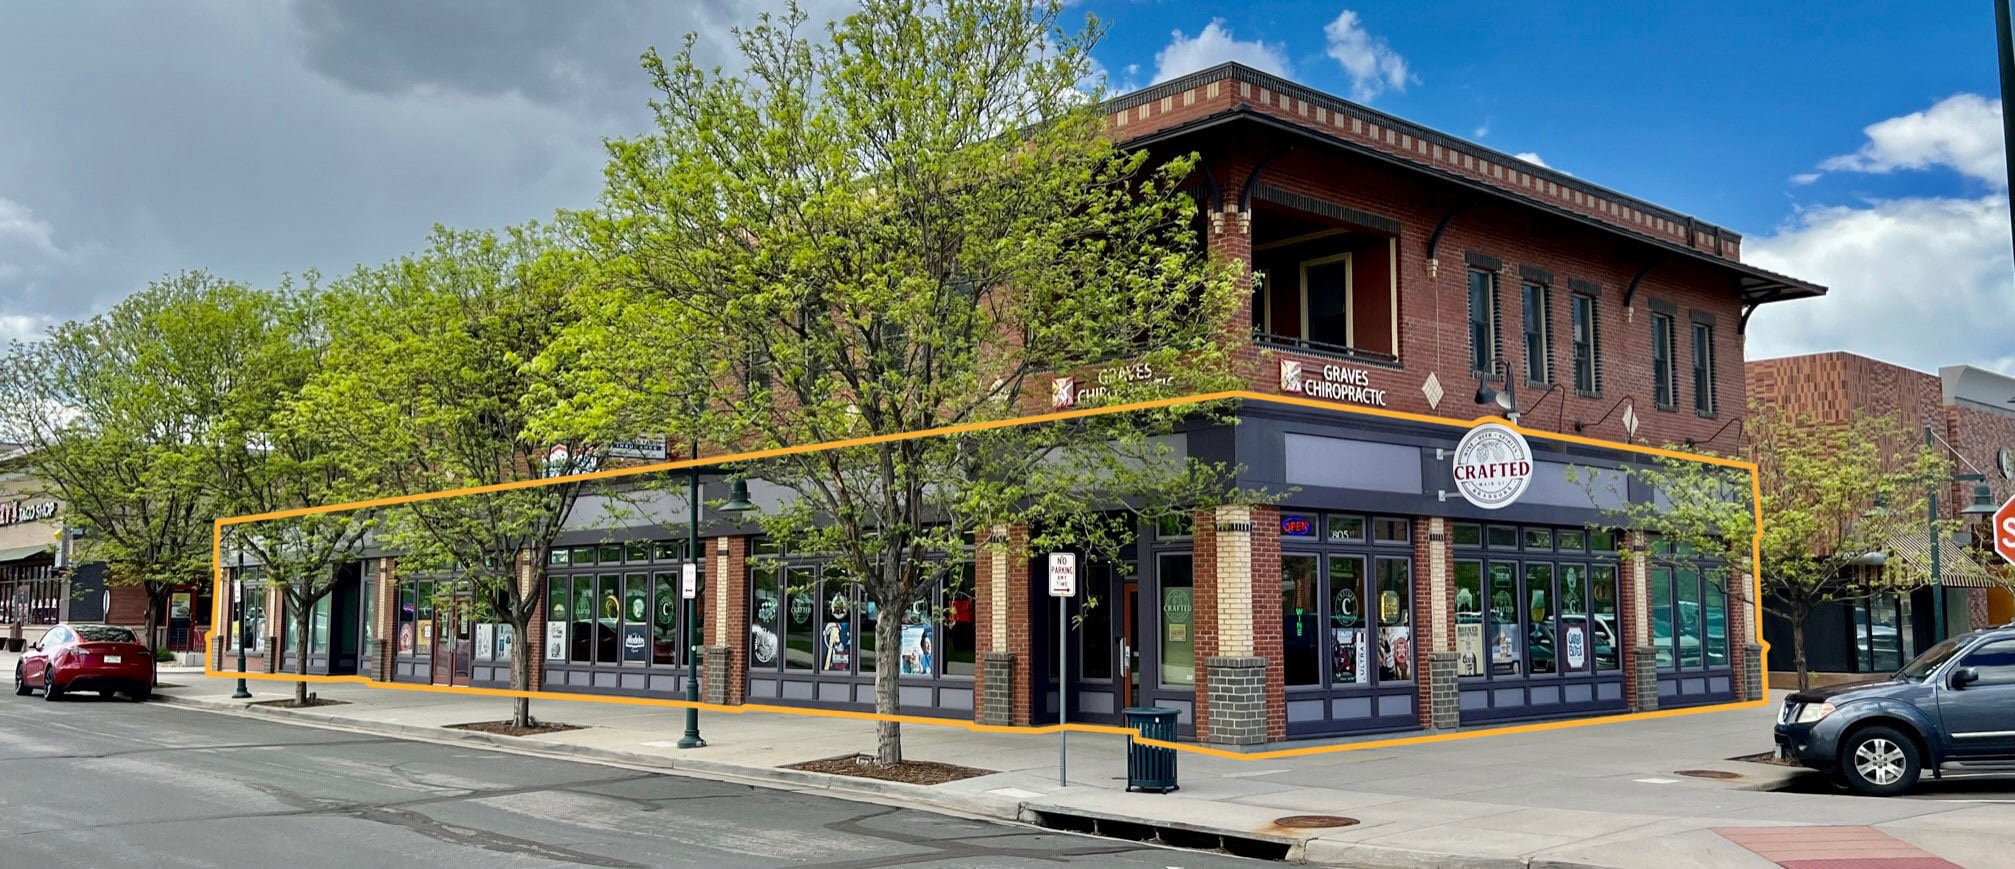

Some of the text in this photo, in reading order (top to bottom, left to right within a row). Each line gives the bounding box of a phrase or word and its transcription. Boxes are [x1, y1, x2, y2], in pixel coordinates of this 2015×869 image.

[1097, 363, 1152, 384] GRAVES
[1323, 364, 1369, 386] GRAVES
[1304, 379, 1386, 406] CHIROPRACTIC
[1454, 461, 1530, 480] CRAFTED
[19, 504, 35, 521] TACO
[36, 502, 54, 517] SHOP
[1285, 521, 1307, 532] OPEN
[1332, 530, 1349, 539] 805
[1051, 566, 1073, 574] PARKING
[1057, 556, 1067, 565] NO
[1163, 604, 1192, 612] CRAFTED
[1295, 607, 1303, 637] WINE
